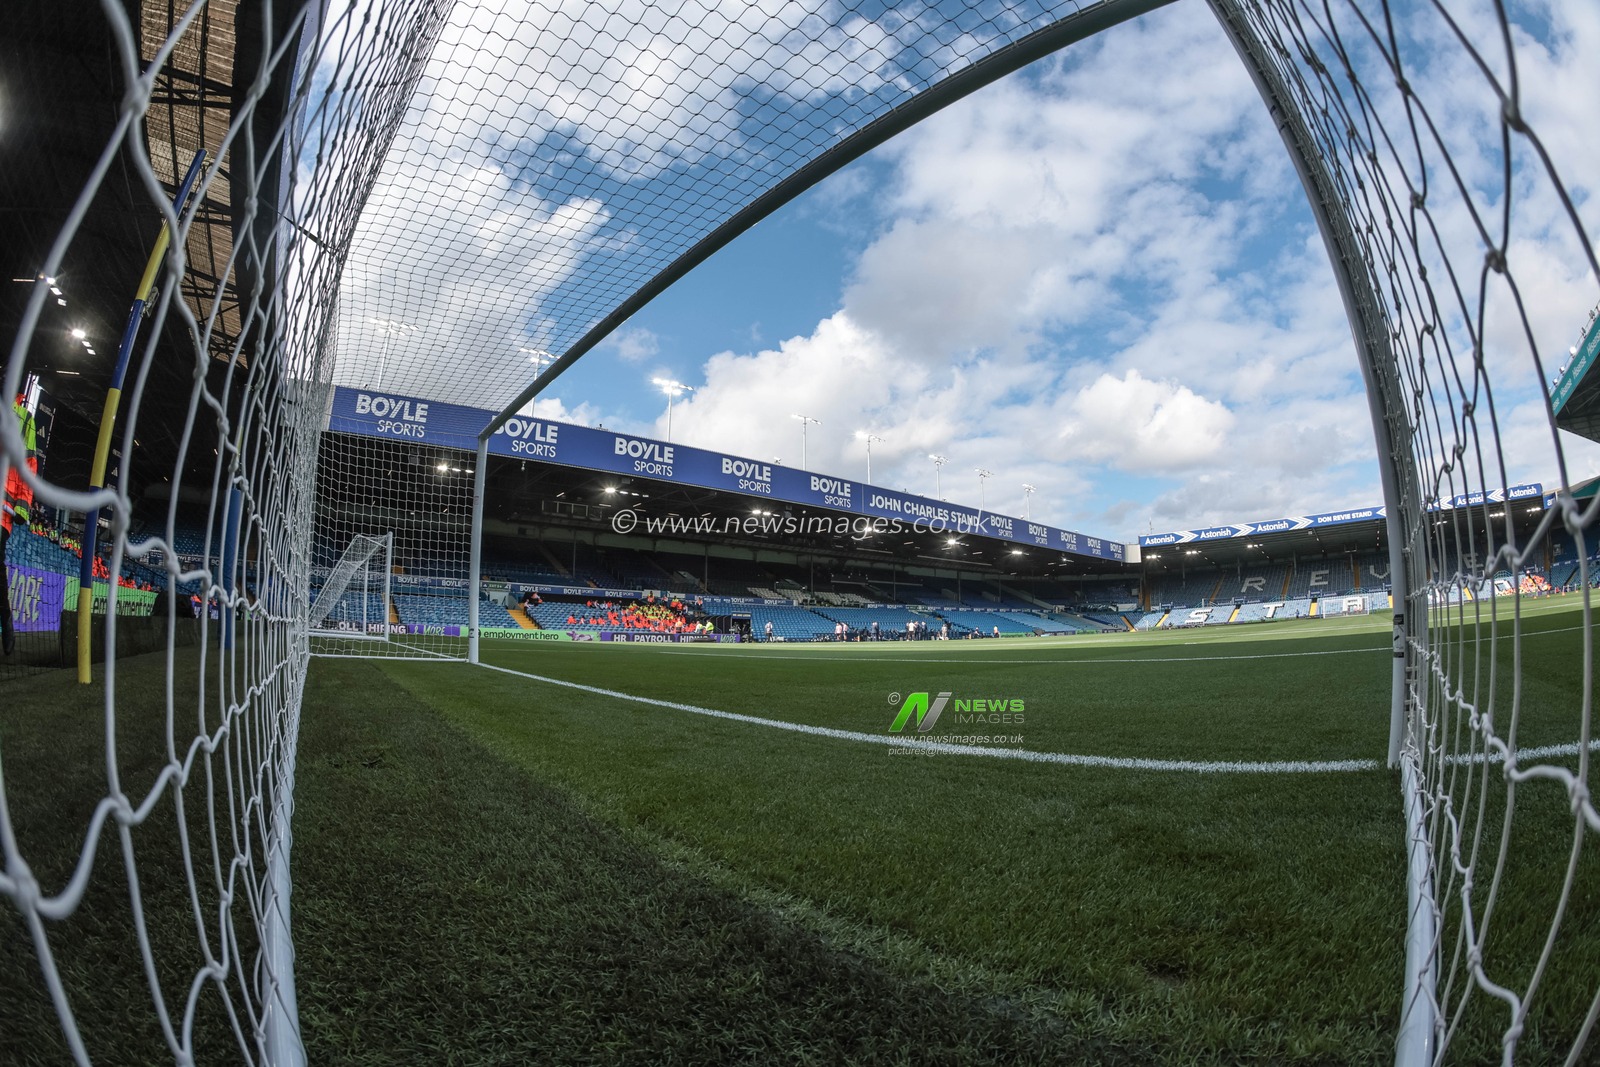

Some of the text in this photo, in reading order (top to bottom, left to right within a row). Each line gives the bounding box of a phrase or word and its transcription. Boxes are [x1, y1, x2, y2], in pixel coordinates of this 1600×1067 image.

[356, 394, 428, 423] BOYLE
[377, 419, 425, 438] SPORTS
[511, 439, 556, 458] SPORTS
[614, 437, 674, 464] BOYLE
[634, 460, 673, 477] SPORTS
[722, 457, 771, 482] BOYLE
[738, 479, 771, 494] SPORTS
[810, 475, 851, 497] BOYLE
[1509, 486, 1537, 499] Astonish
[824, 494, 851, 508] SPORTS
[869, 494, 979, 527] JOHN CHARLES STAND
[1317, 511, 1373, 524] DON REVIE STAND
[990, 515, 1013, 530] BOYLE
[1257, 521, 1289, 533] Astonish
[998, 528, 1013, 539] SPORTS
[1028, 524, 1048, 537] BOYLE
[1060, 531, 1077, 544] BOYLE
[1200, 528, 1232, 540] Astonish
[1144, 535, 1176, 546] Astonish
[613, 634, 627, 642] HR
[634, 634, 673, 643] PAYROLL
